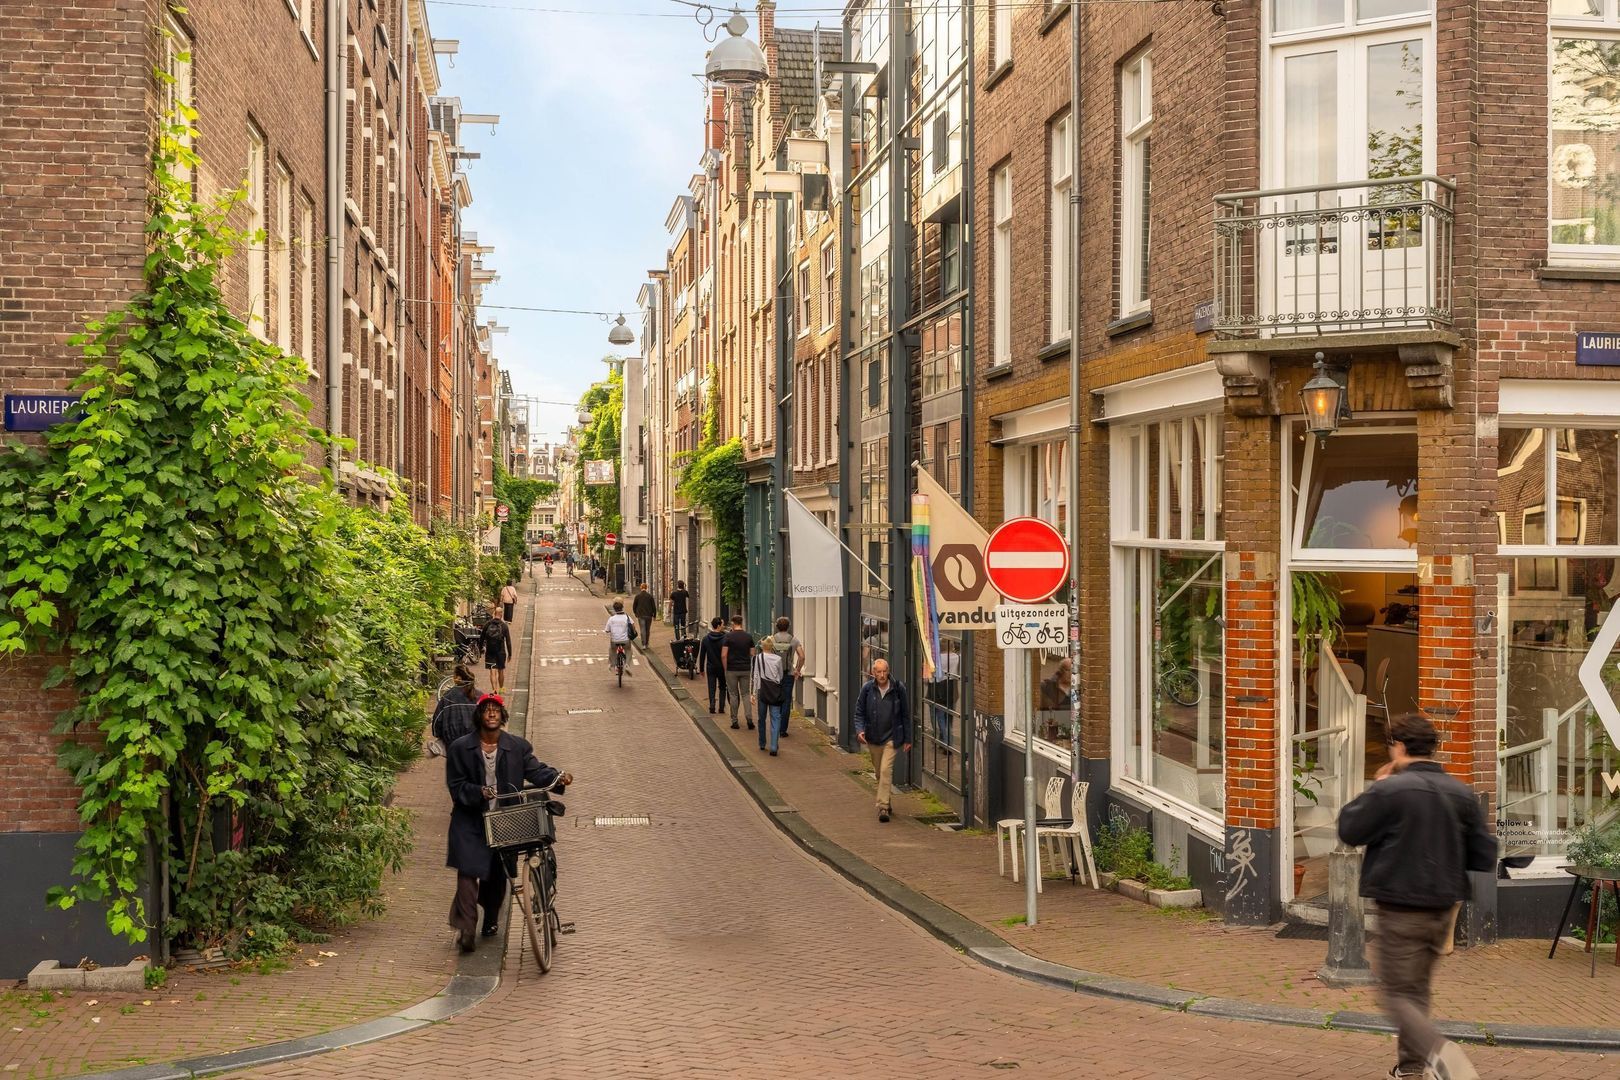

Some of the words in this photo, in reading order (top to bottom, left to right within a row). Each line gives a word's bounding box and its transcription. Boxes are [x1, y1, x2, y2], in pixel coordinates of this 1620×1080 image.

[1418, 562, 1432, 578] 71
[794, 584, 840, 595] Kersgallery
[1000, 608, 1065, 620] uitgezonderd
[1496, 819, 1521, 827] follow
